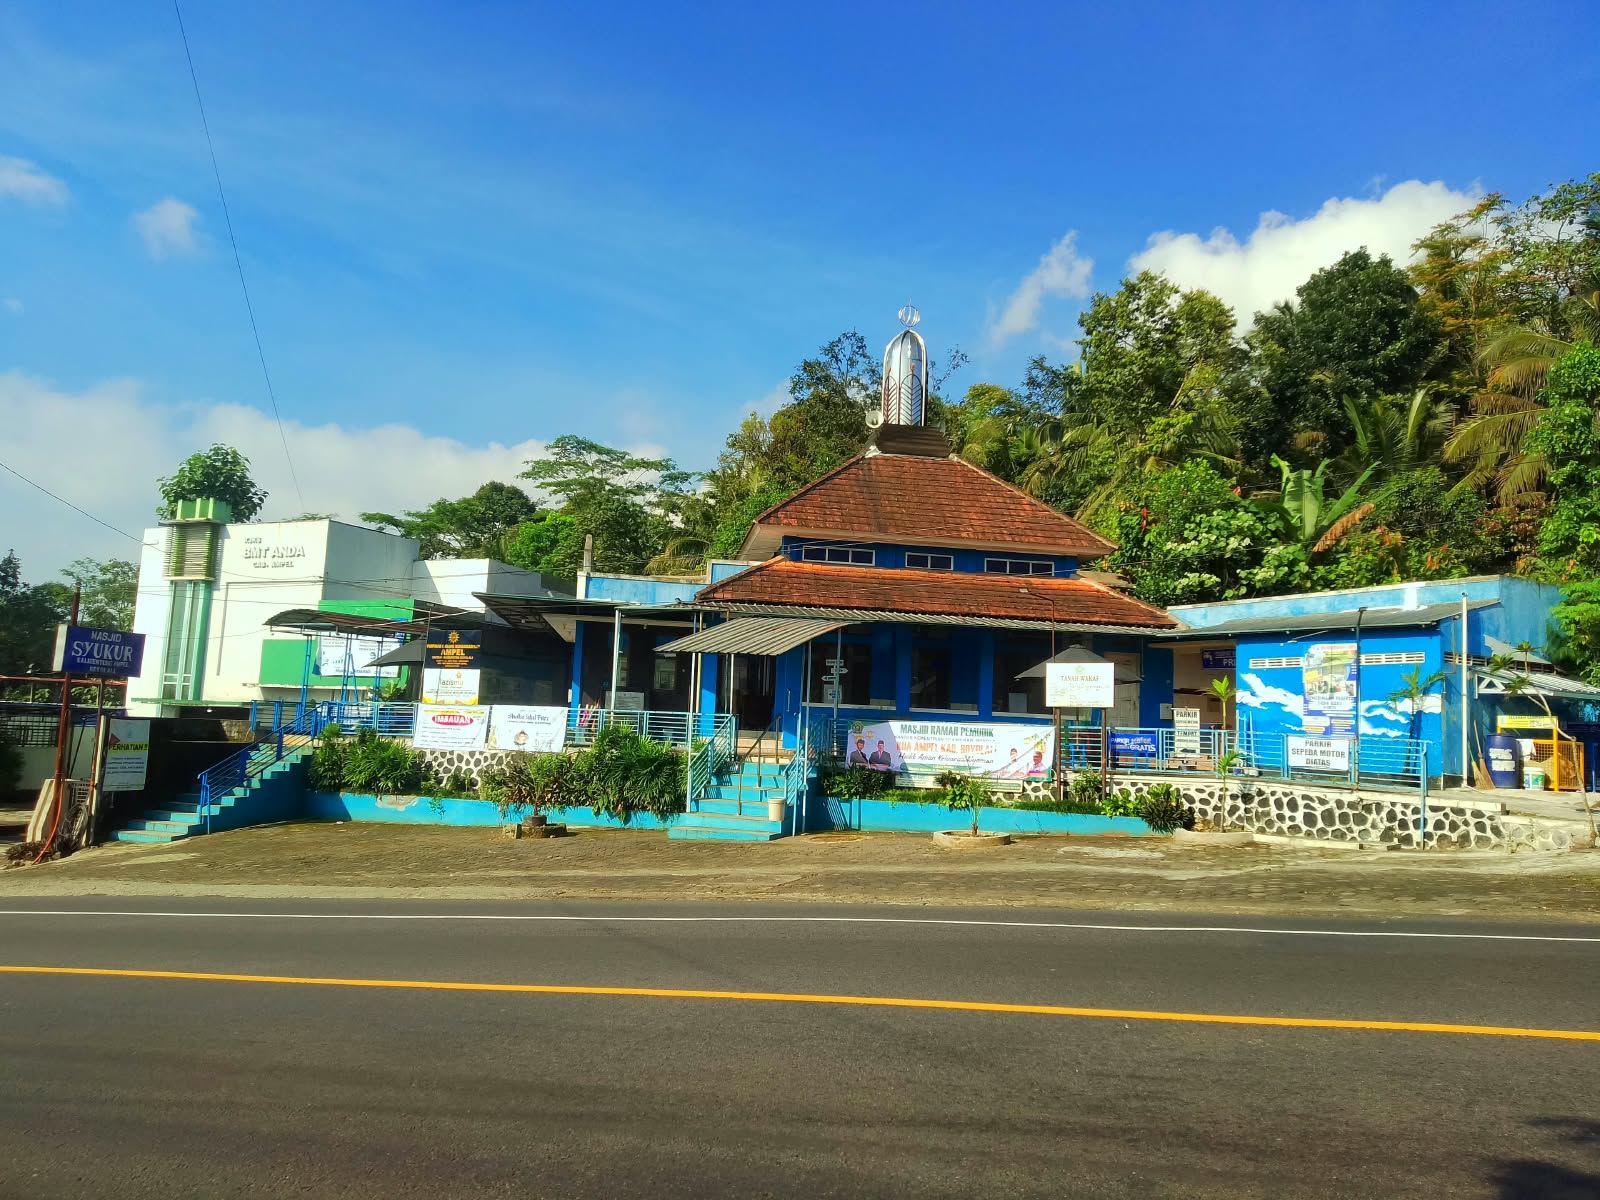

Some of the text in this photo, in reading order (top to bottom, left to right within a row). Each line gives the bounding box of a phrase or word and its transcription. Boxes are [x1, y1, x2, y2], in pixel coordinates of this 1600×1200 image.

[243, 545, 306, 559] BMT ANDA
[271, 560, 295, 569] AMPEL
[90, 630, 122, 643] MASJID
[71, 640, 134, 662] SYUKUR
[440, 648, 466, 656] AMPEL
[1175, 711, 1199, 719] PARKIR
[900, 723, 994, 738] MASJID RAMAH PEMUDIK
[913, 742, 938, 752] AMPEL
[1129, 743, 1156, 752] GRATIS
[1305, 740, 1331, 748] PARKIR
[1291, 748, 1346, 759] SEPEDA MOTOR
[1305, 758, 1331, 767] DIATAS
